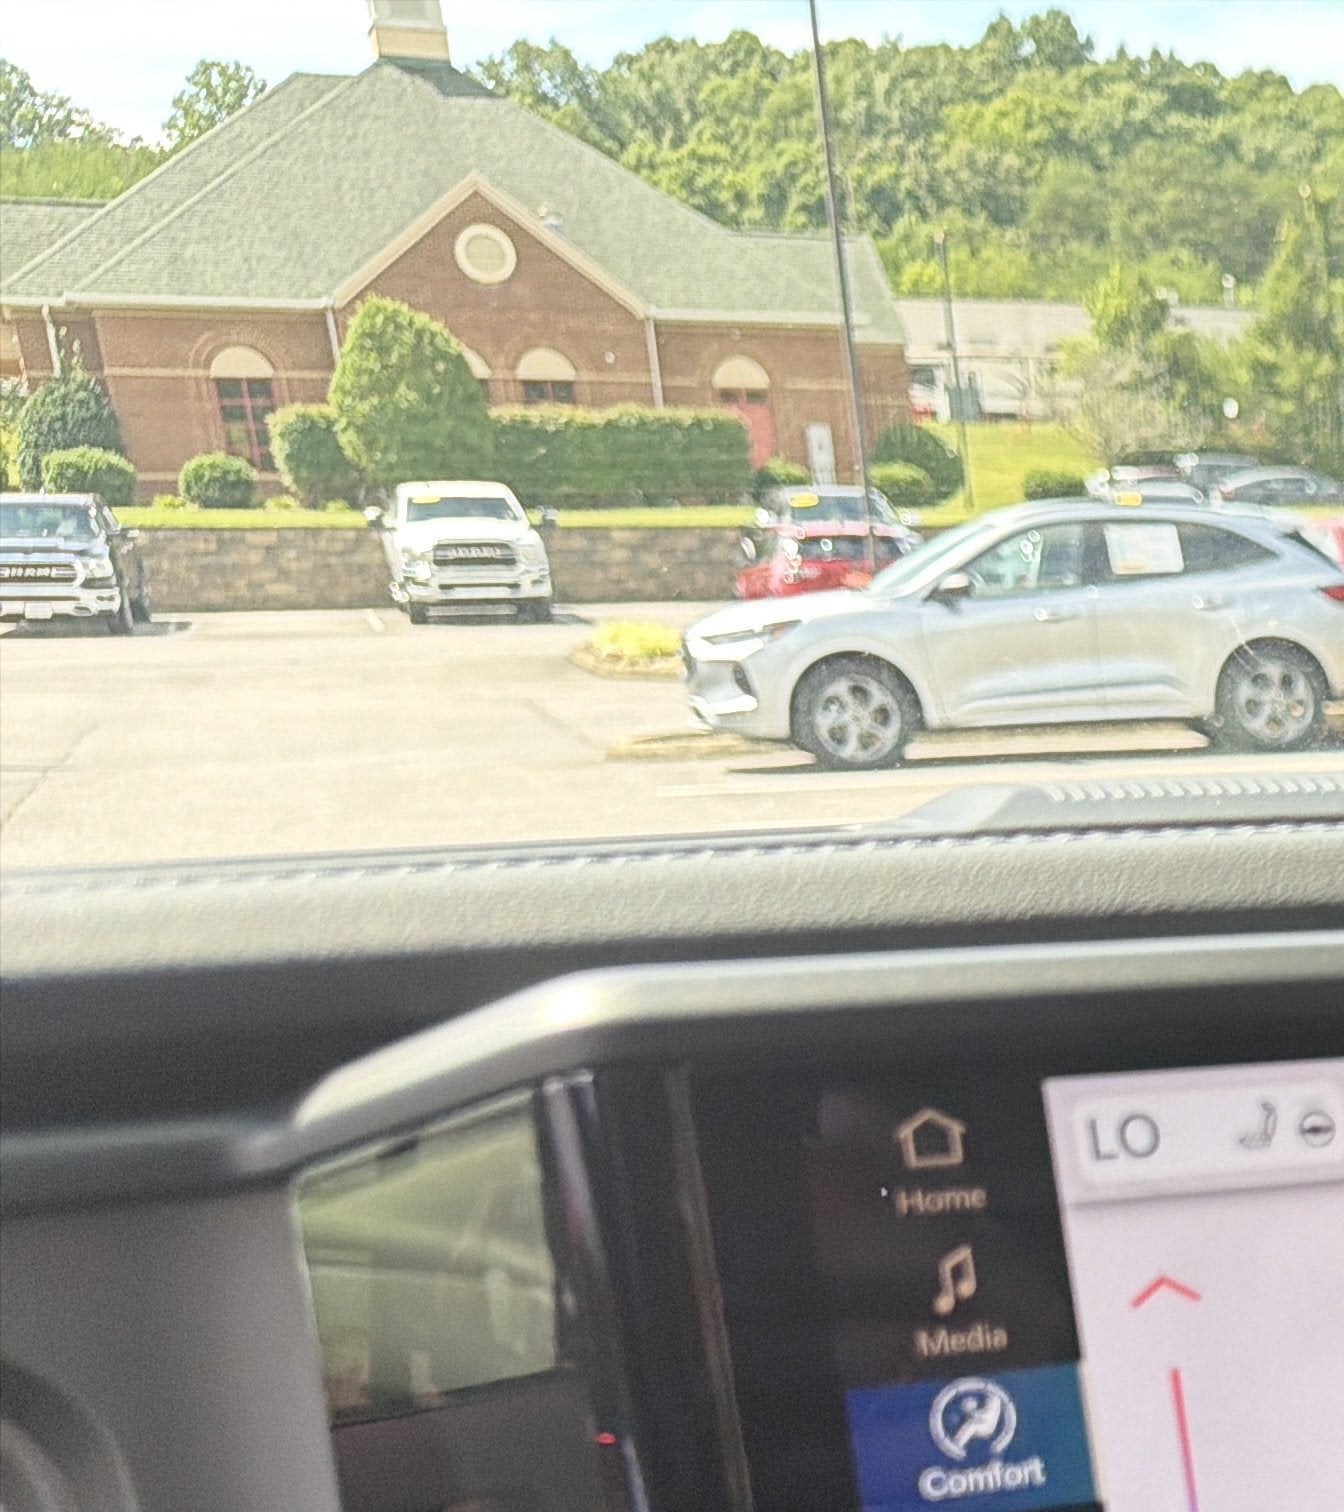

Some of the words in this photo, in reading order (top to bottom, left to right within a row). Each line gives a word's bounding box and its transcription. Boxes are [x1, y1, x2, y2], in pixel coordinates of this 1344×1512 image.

[1089, 1113, 1161, 1162] LO
[895, 1186, 988, 1218] Home
[915, 1323, 1009, 1358] Media
[918, 1455, 1048, 1501] Comfort
